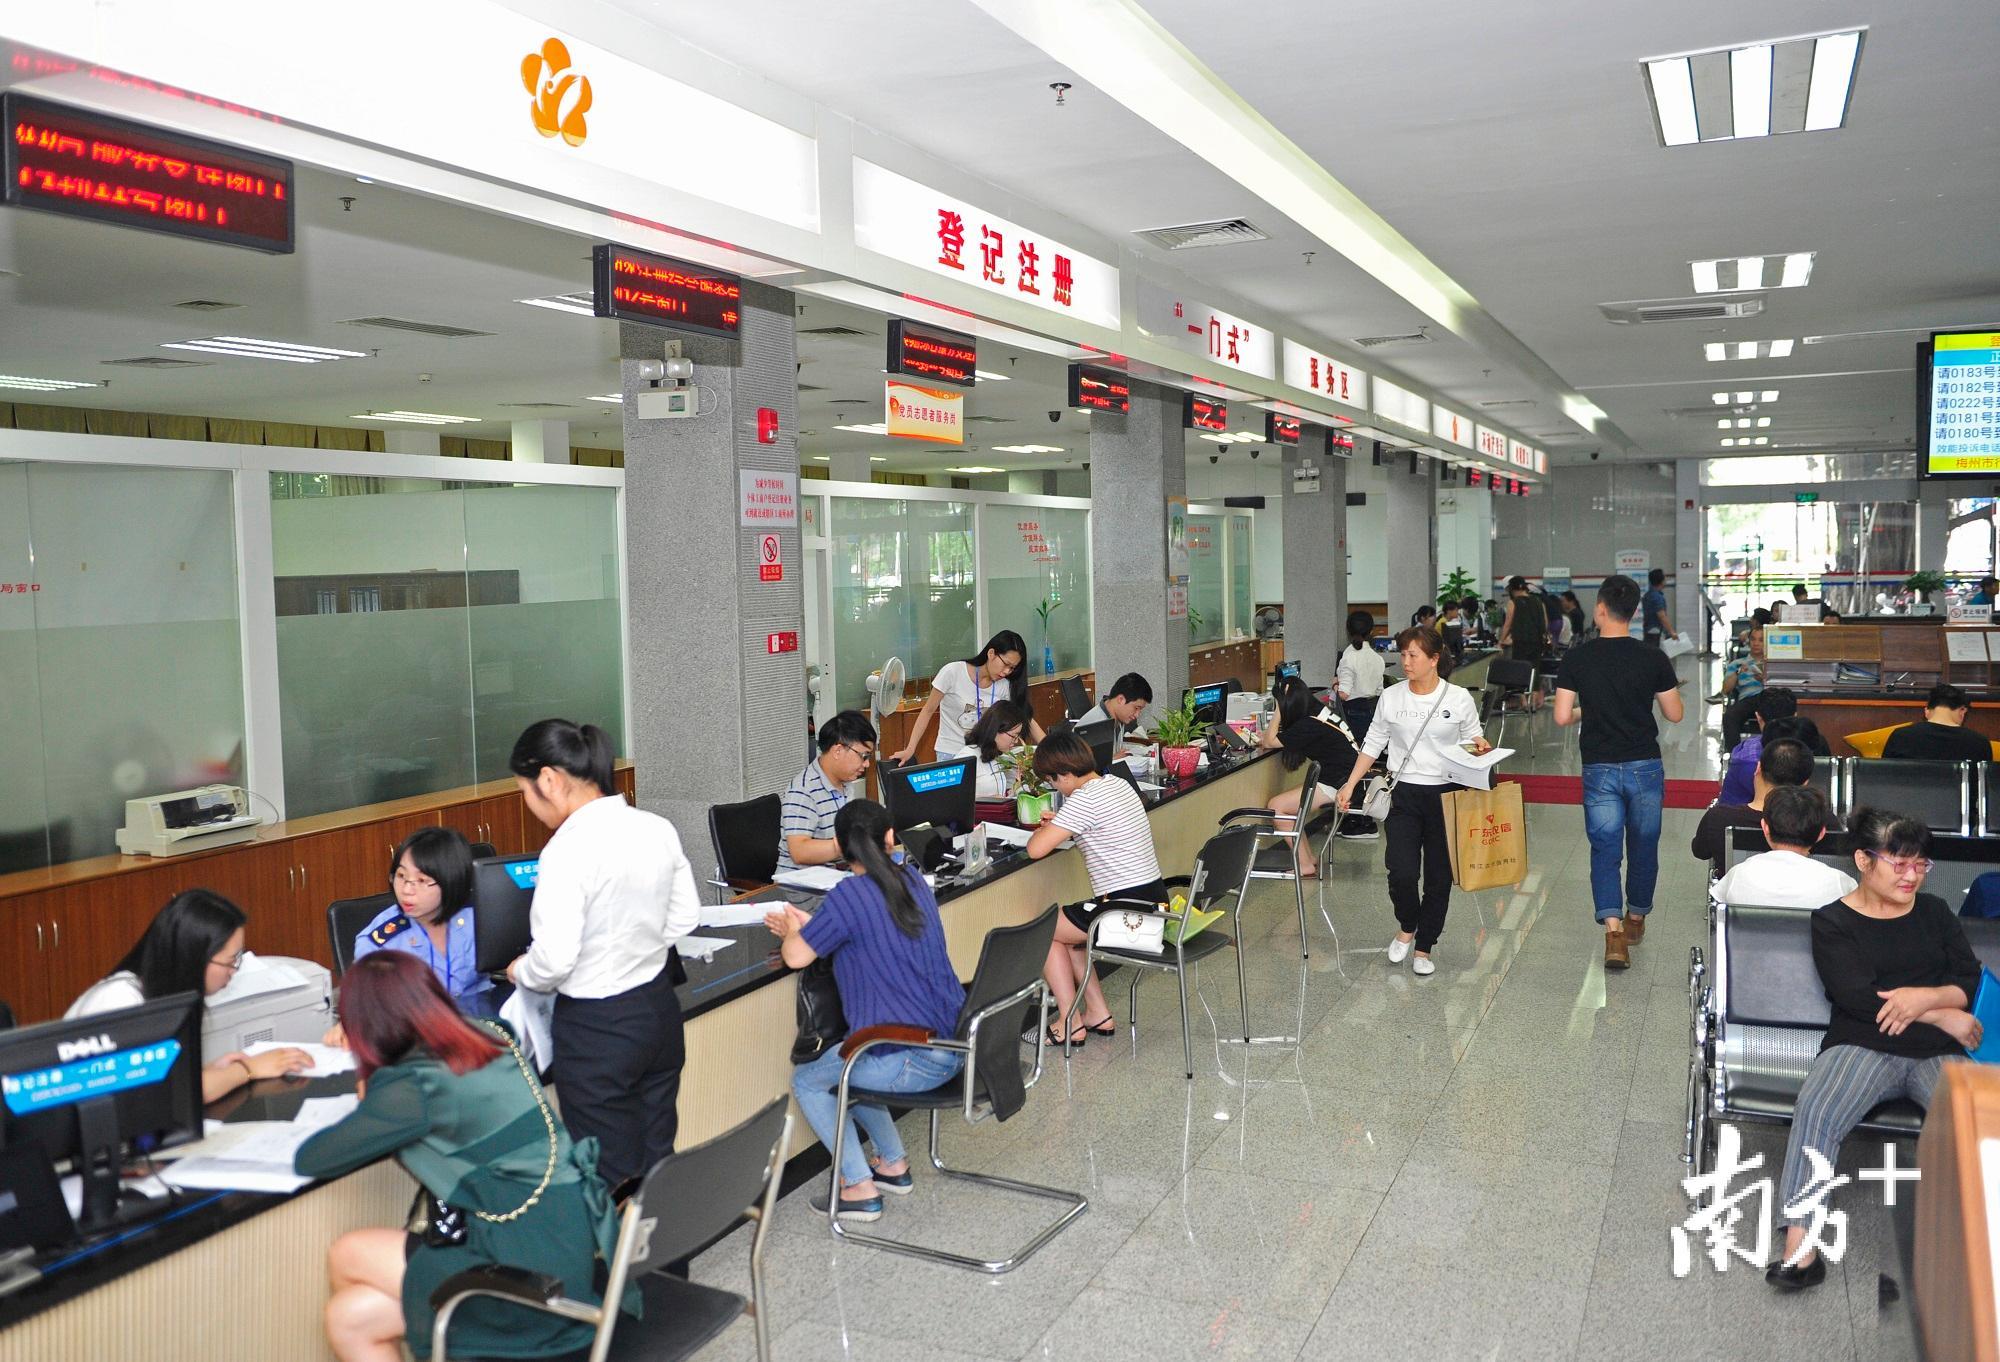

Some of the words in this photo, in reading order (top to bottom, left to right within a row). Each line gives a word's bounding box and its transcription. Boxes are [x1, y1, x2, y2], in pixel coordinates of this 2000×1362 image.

[937, 208, 1074, 307] 登记注册
[1174, 301, 1250, 364] “一门式”
[1310, 356, 1350, 400] 服务区
[1938, 367, 2000, 379] 请0183号
[1937, 381, 2000, 395] 请0182号
[899, 403, 957, 426] 党员志愿者服务岗
[58, 1034, 117, 1062] DELL
